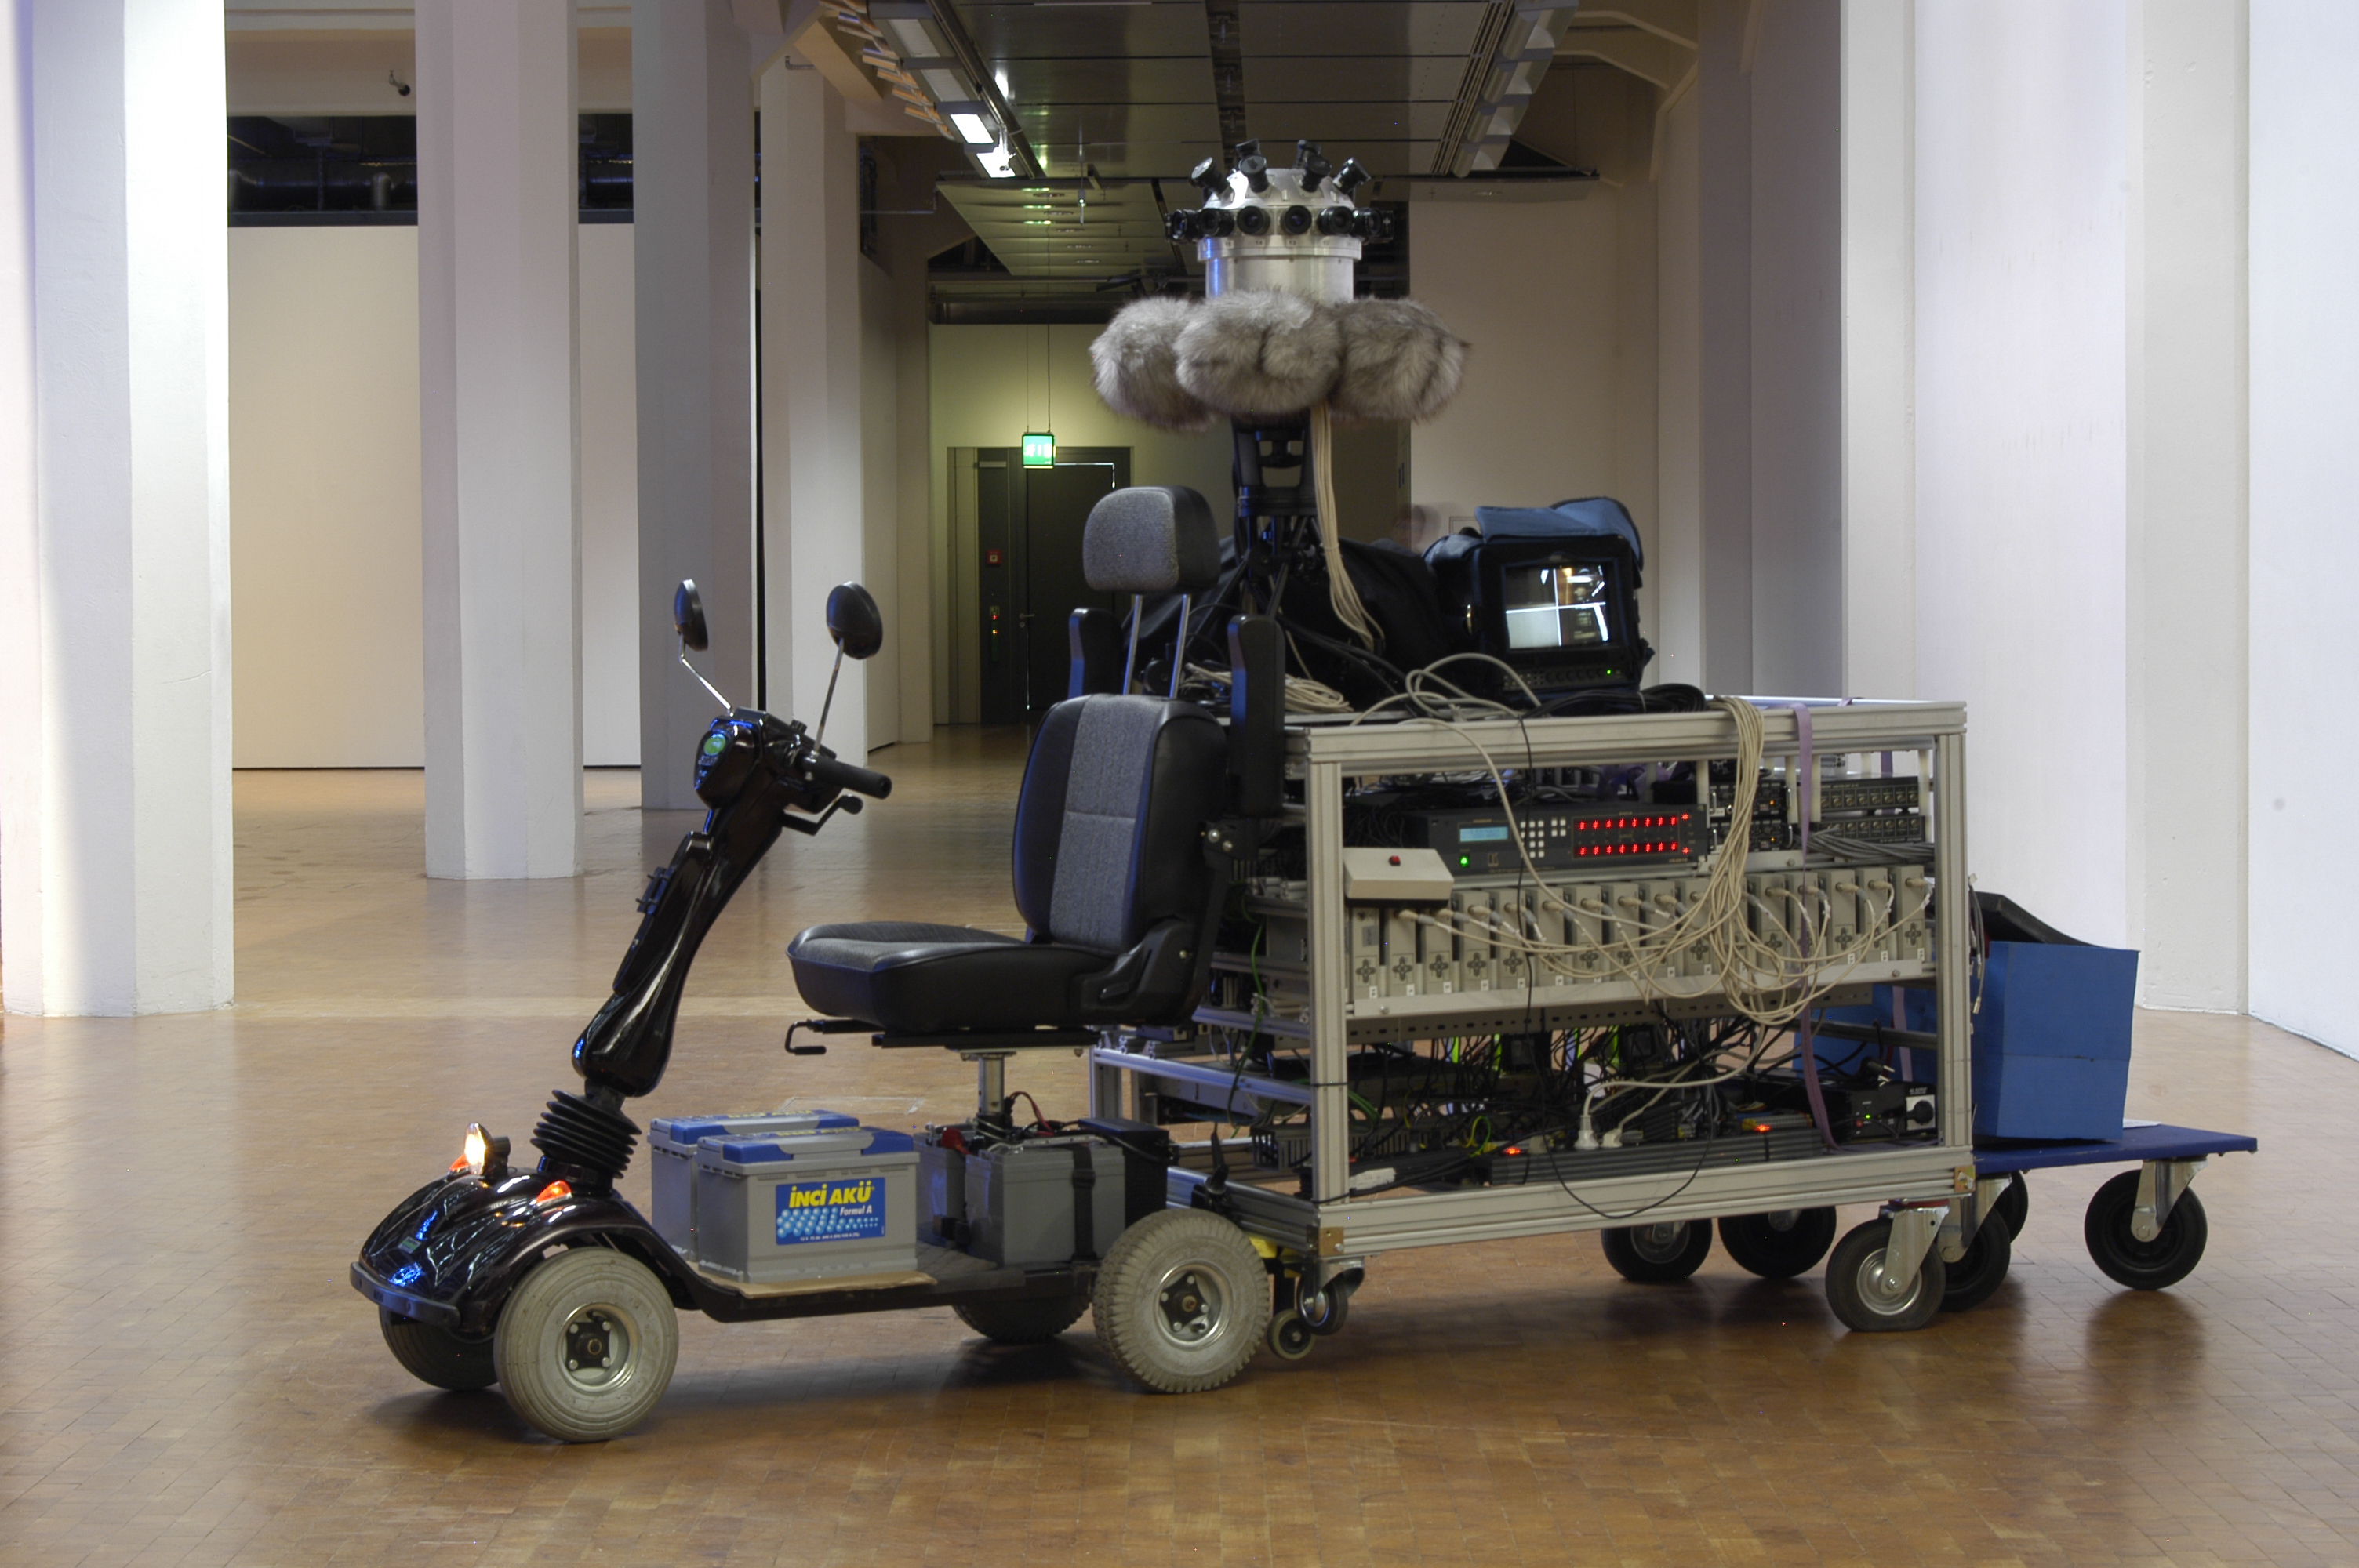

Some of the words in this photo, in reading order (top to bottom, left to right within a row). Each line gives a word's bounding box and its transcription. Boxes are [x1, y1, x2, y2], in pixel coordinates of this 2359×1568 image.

[828, 1180, 872, 1205] AKÜ
[840, 1206, 865, 1216] Formul
[866, 1205, 872, 1214] A
